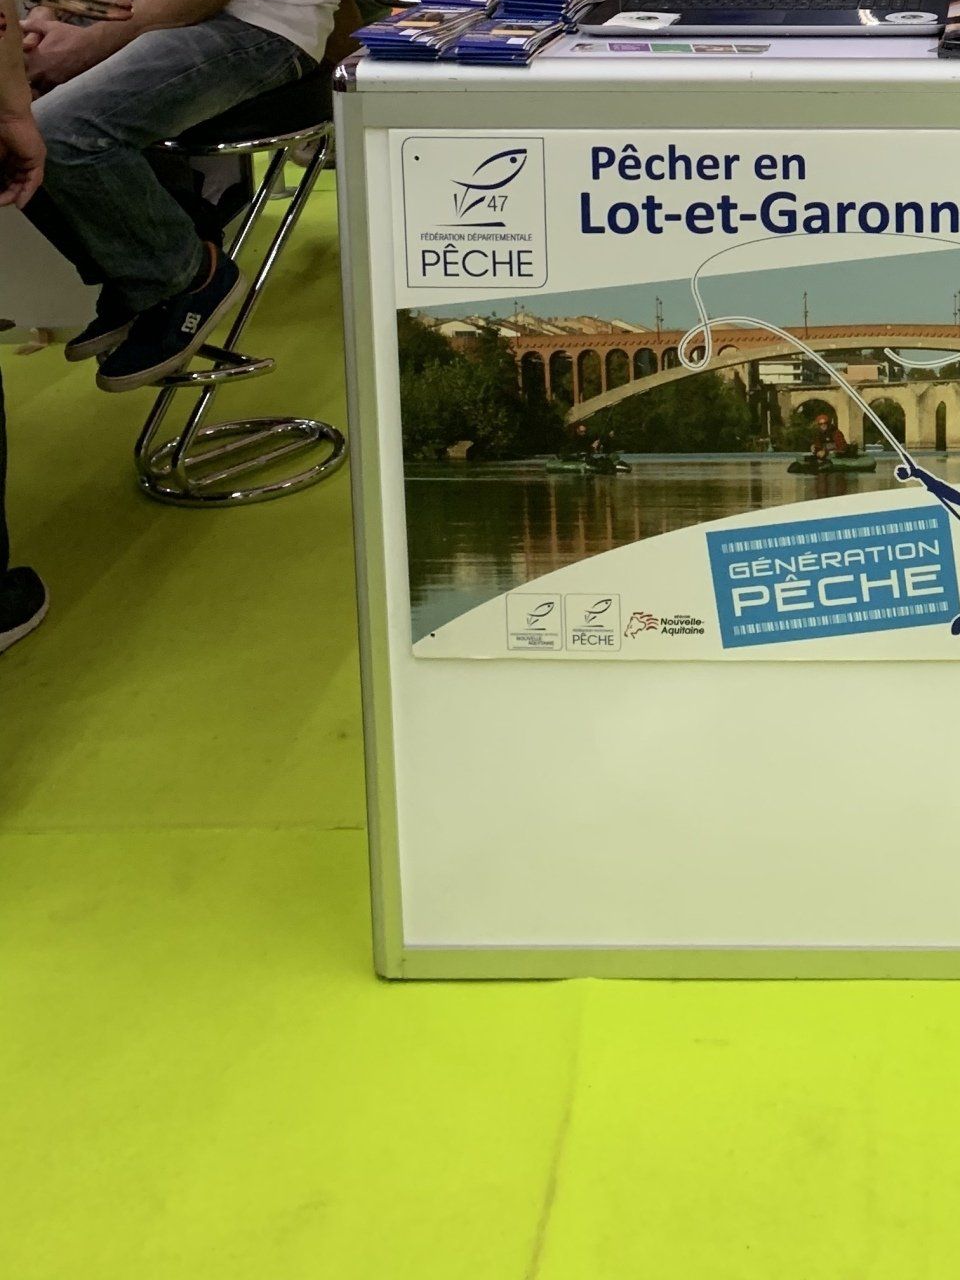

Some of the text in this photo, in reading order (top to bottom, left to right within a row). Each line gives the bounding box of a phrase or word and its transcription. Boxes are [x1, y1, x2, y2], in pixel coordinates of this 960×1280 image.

[591, 144, 806, 181] Pêcher en
[487, 196, 508, 212] 47
[421, 232, 533, 242] FÉDÉRATION DÉPARTEMENTALE
[422, 243, 533, 277] PÊCHE
[728, 537, 941, 582] GÉNÉRATION
[732, 565, 946, 617] PÊCHE
[660, 617, 704, 626] Nouvelle-
[661, 626, 705, 636] Aquitaine
[572, 633, 614, 646] PÊCHE
